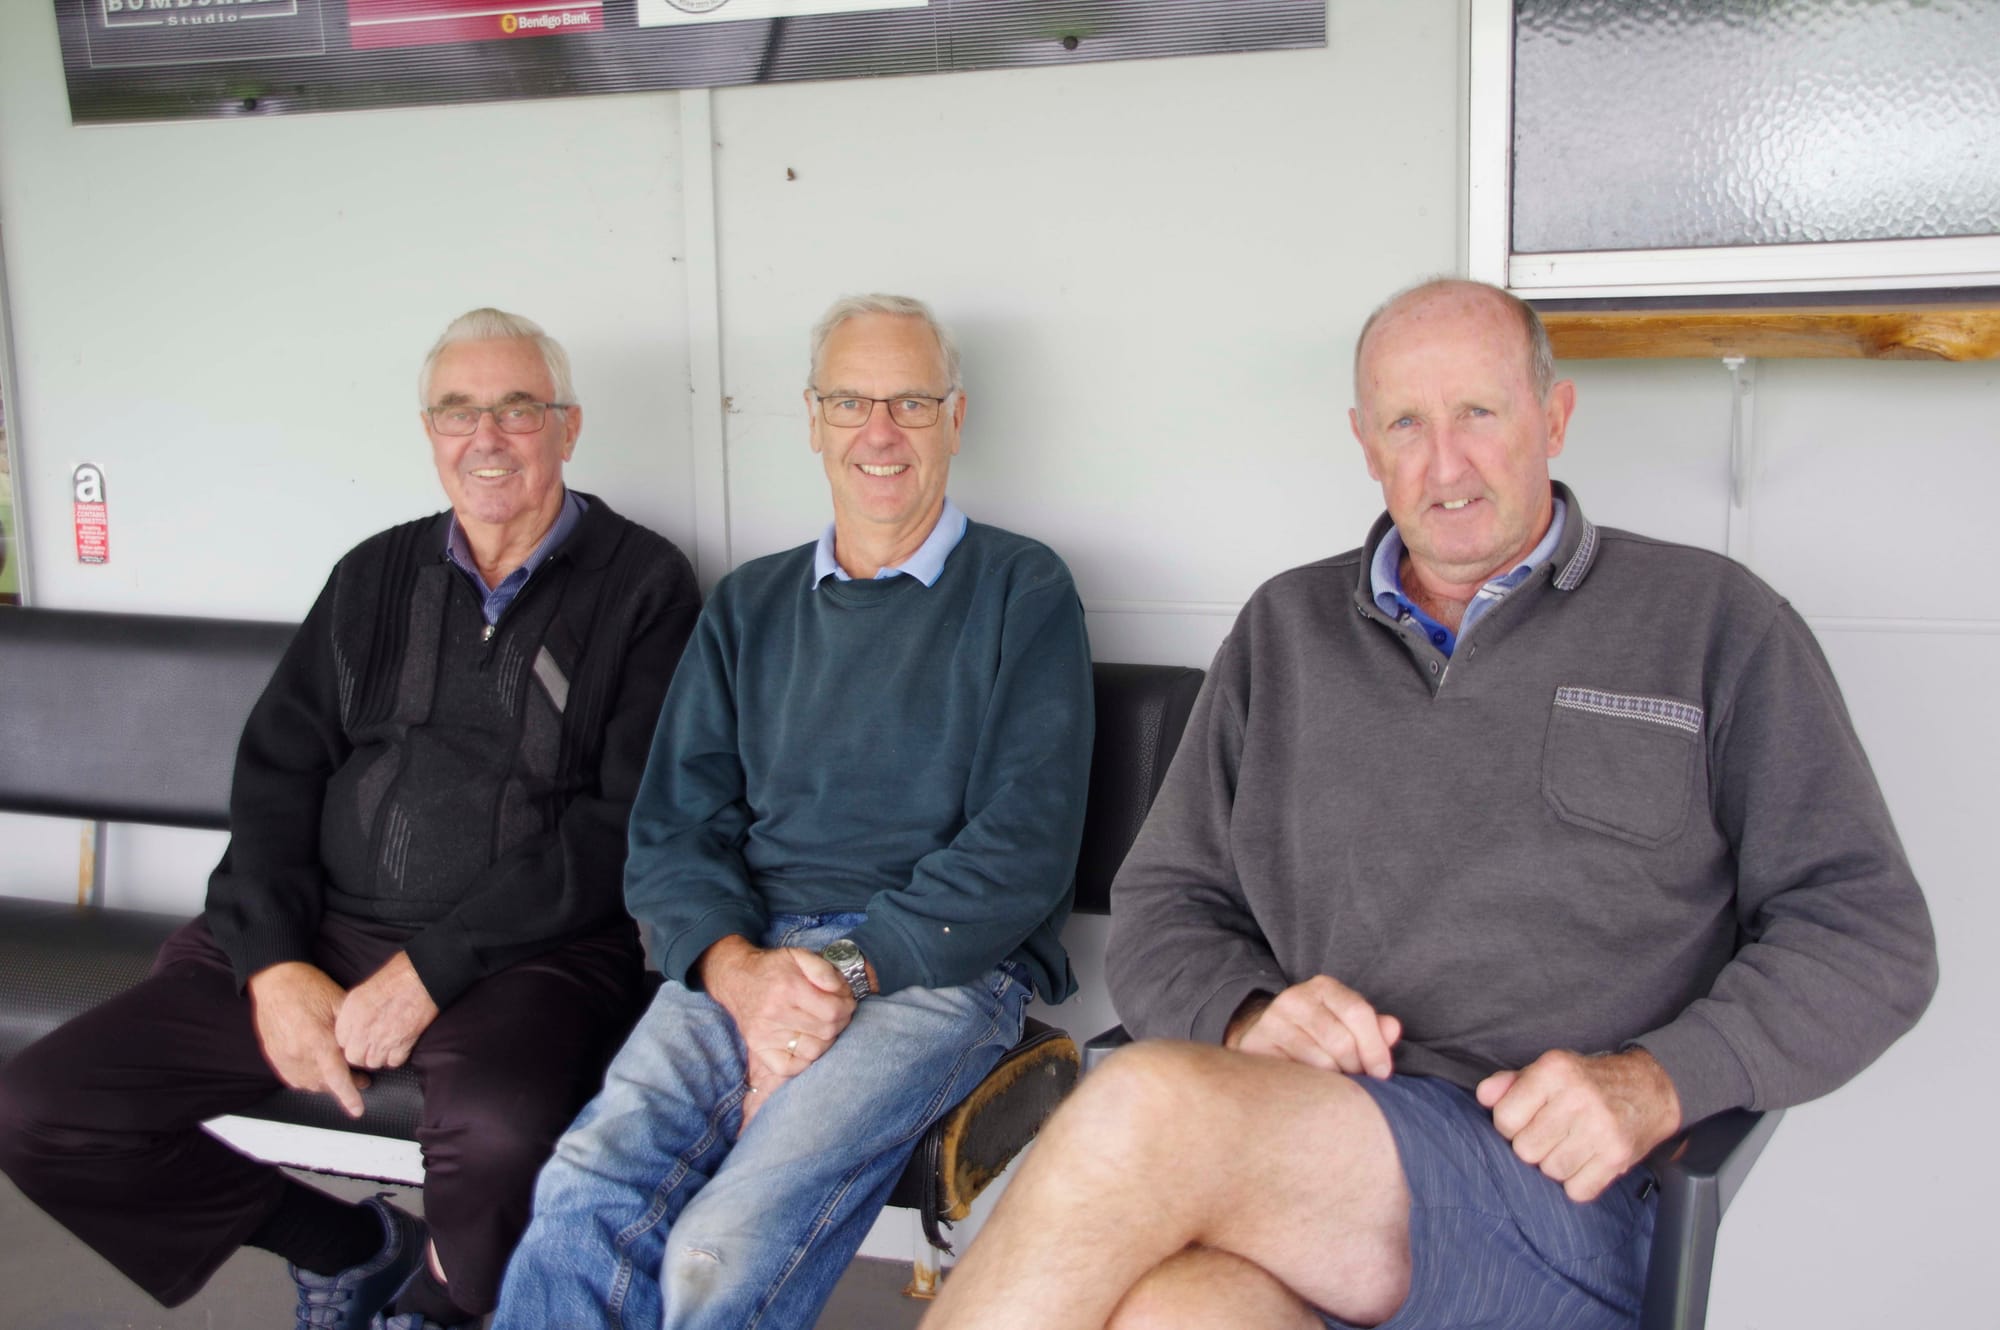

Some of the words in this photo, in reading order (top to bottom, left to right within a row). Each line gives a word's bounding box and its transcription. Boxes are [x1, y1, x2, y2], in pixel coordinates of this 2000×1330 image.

[167, 13, 238, 26] Studio
[519, 15, 561, 29] Bendigo
[563, 12, 591, 25] Bank
[76, 467, 104, 503] a
